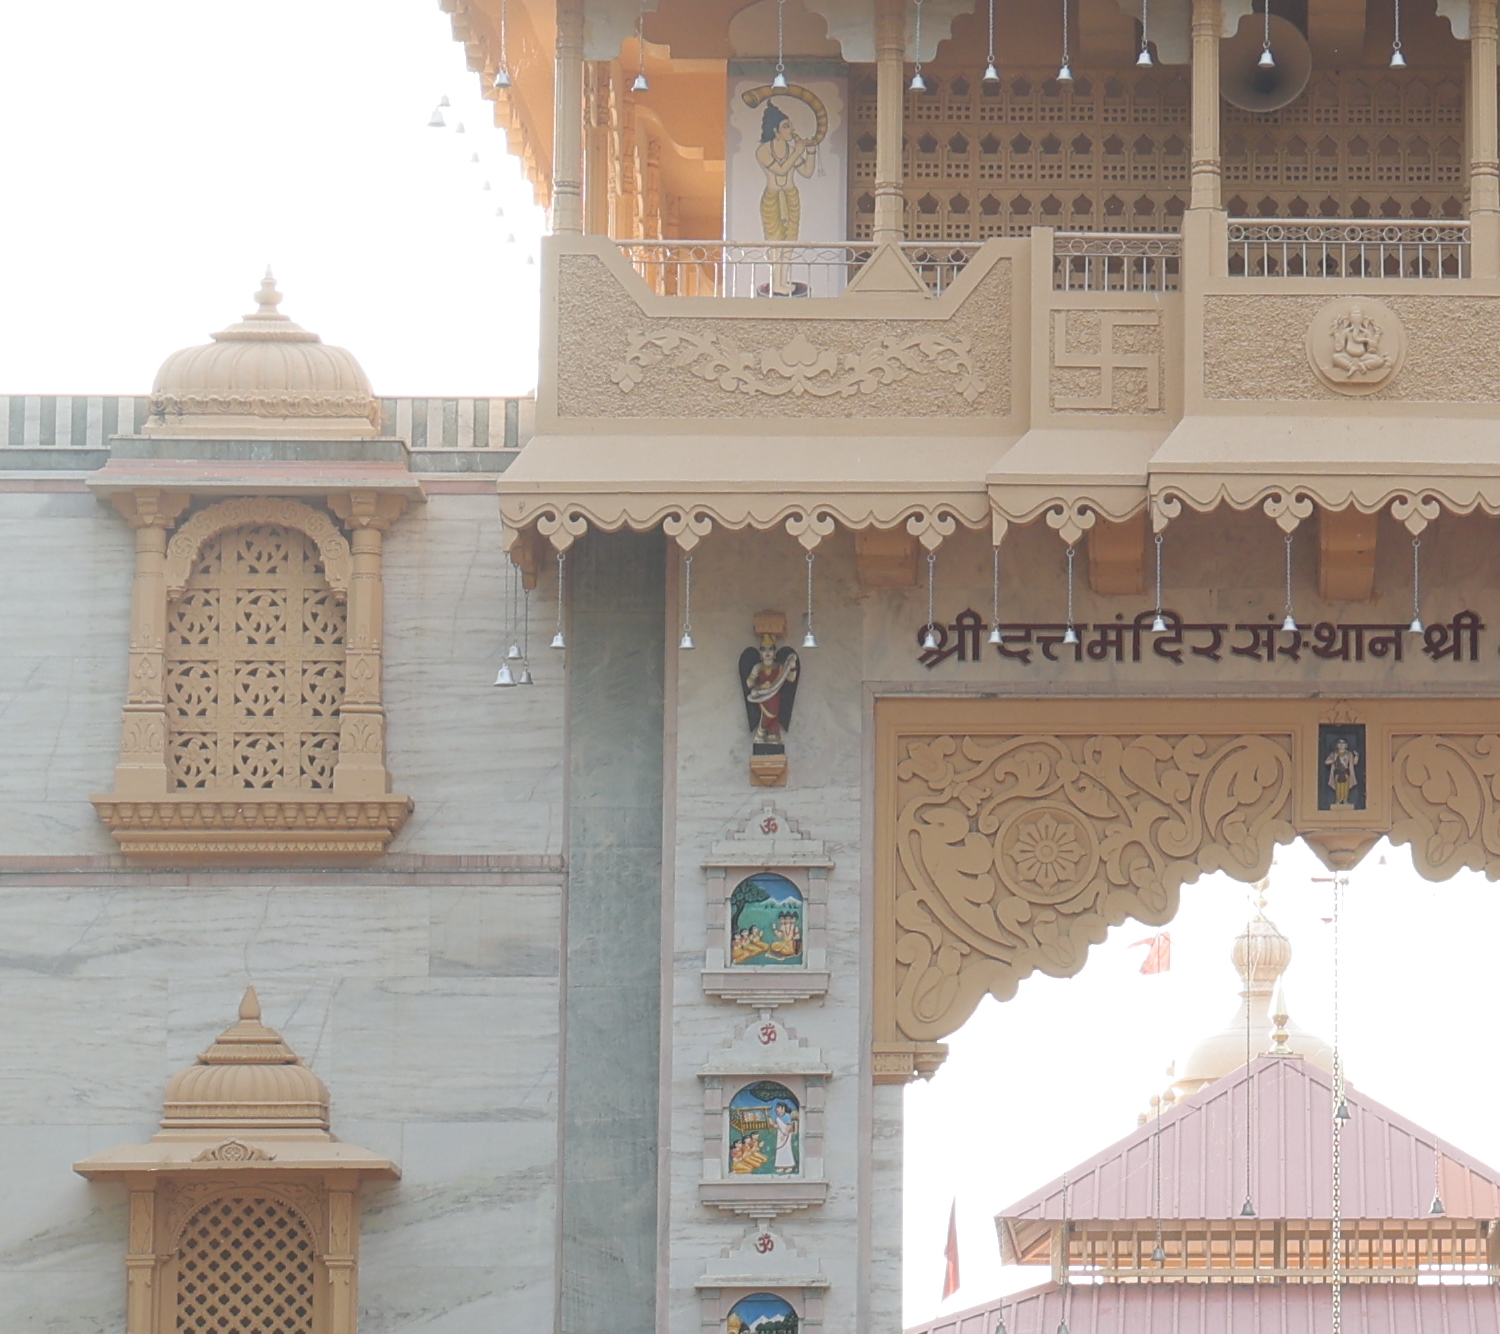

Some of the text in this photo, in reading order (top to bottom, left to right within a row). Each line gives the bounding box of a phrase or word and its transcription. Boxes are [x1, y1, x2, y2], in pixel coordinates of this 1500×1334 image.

[917, 607, 988, 668] श्री
[1231, 612, 1413, 663] संस्थान
[1422, 609, 1486, 663] श्री
